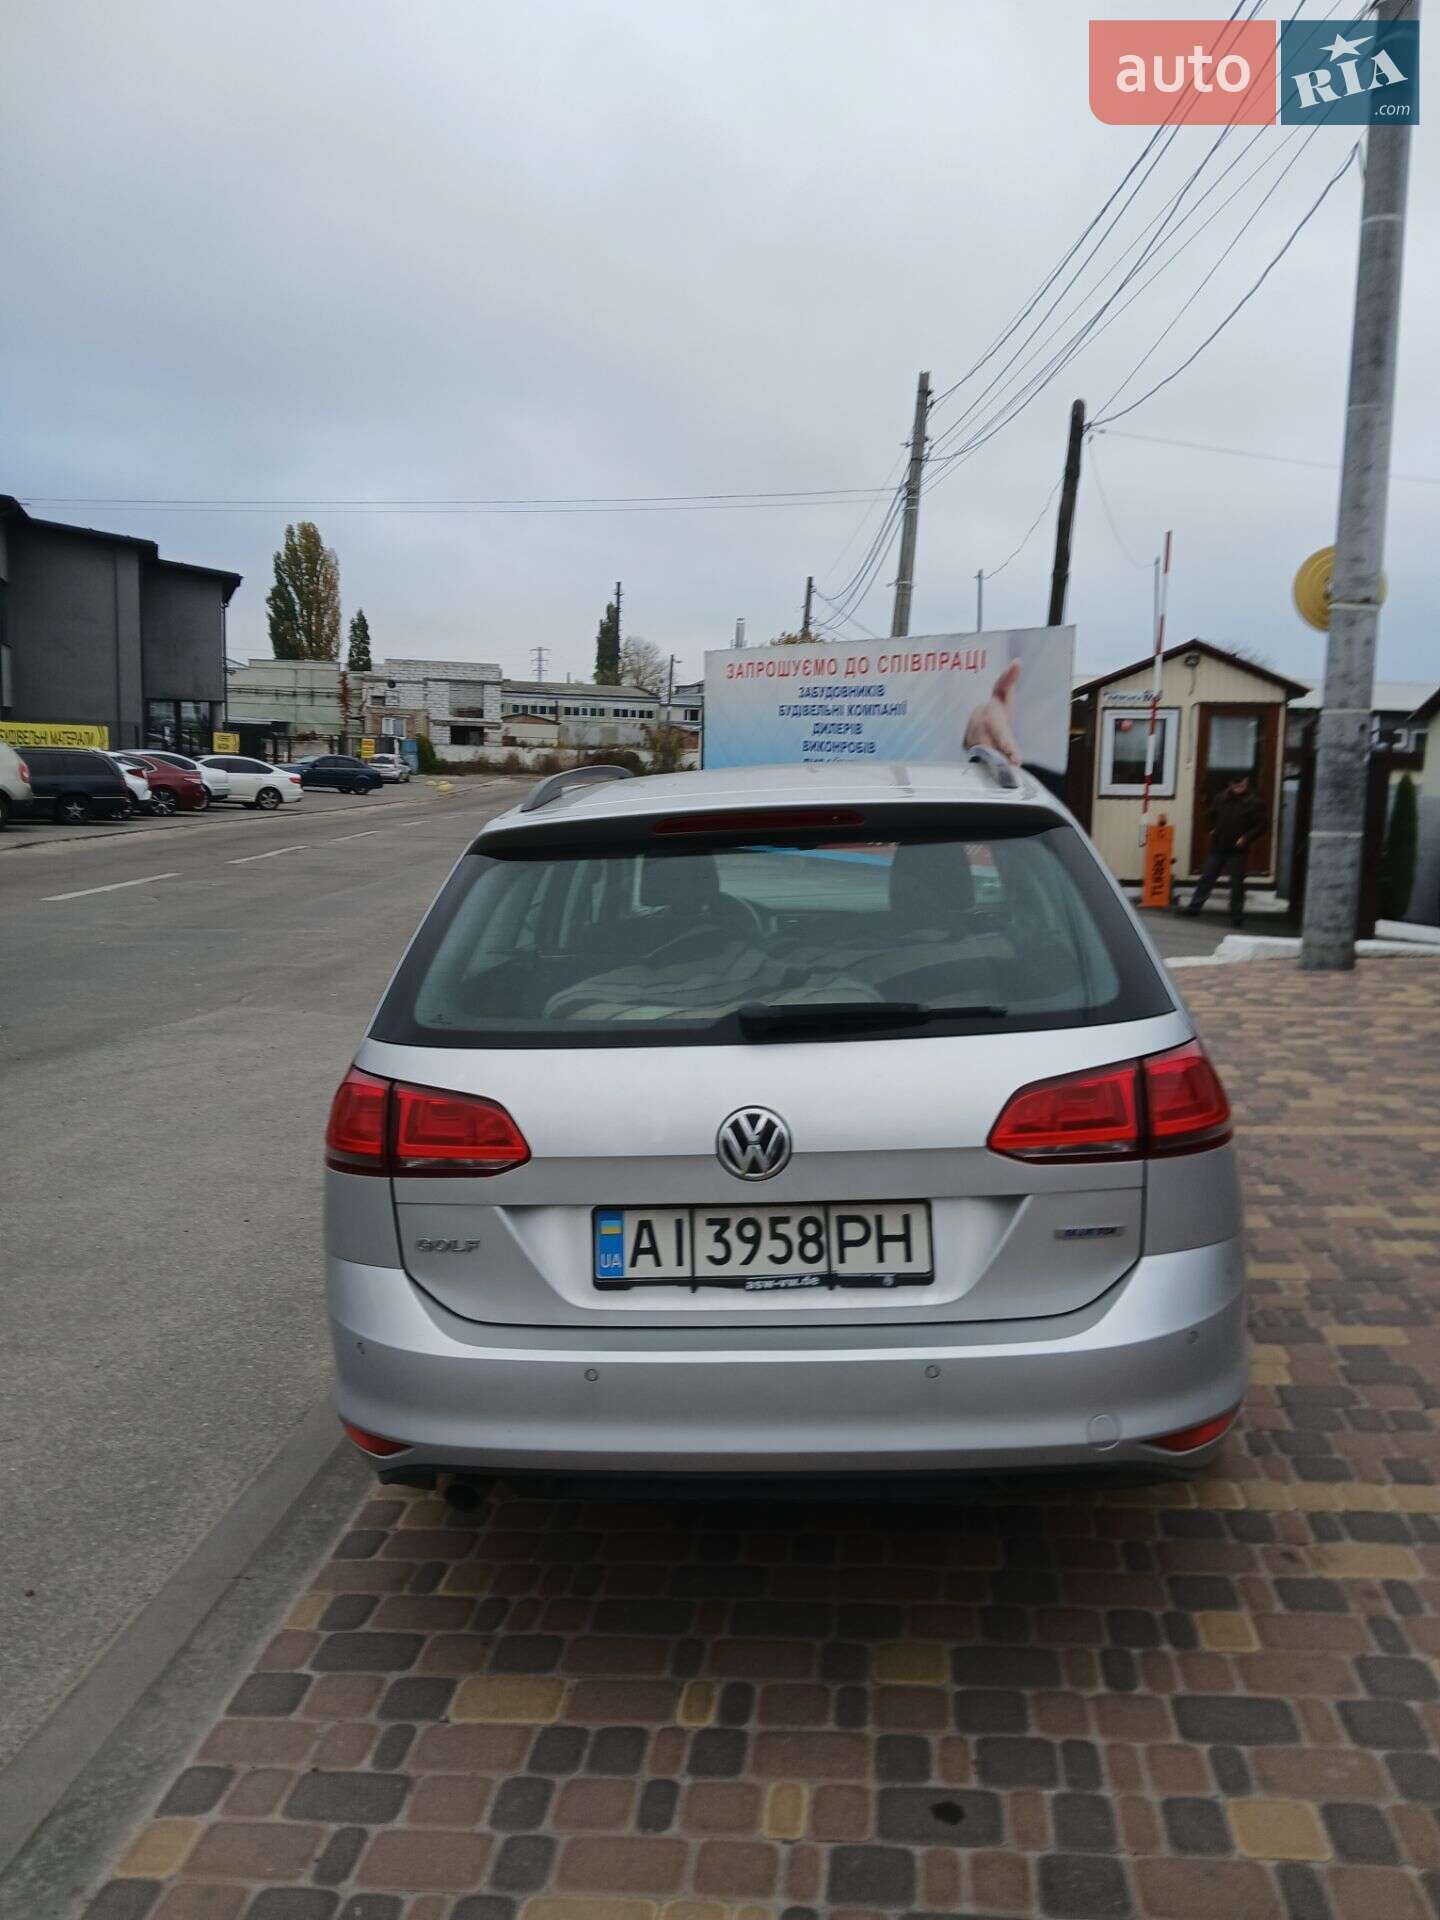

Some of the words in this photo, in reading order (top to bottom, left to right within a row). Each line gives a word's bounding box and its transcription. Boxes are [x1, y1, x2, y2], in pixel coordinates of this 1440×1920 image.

[726, 658, 837, 680] ЗАПРОШУЄМО
[844, 656, 870, 678] ДО
[877, 650, 987, 674] СПІВПРАЦІ
[798, 684, 886, 700] ЗАБУДОВНИКІВ
[778, 704, 844, 718] БУДІВЕЛЬНІ
[812, 722, 864, 736] ДИЛЕРІВ
[416, 1238, 480, 1252] GOLF
[601, 1252, 624, 1269] UA
[629, 1218, 685, 1268] AI
[705, 1215, 825, 1266] 3958
[836, 1213, 913, 1265] PH
